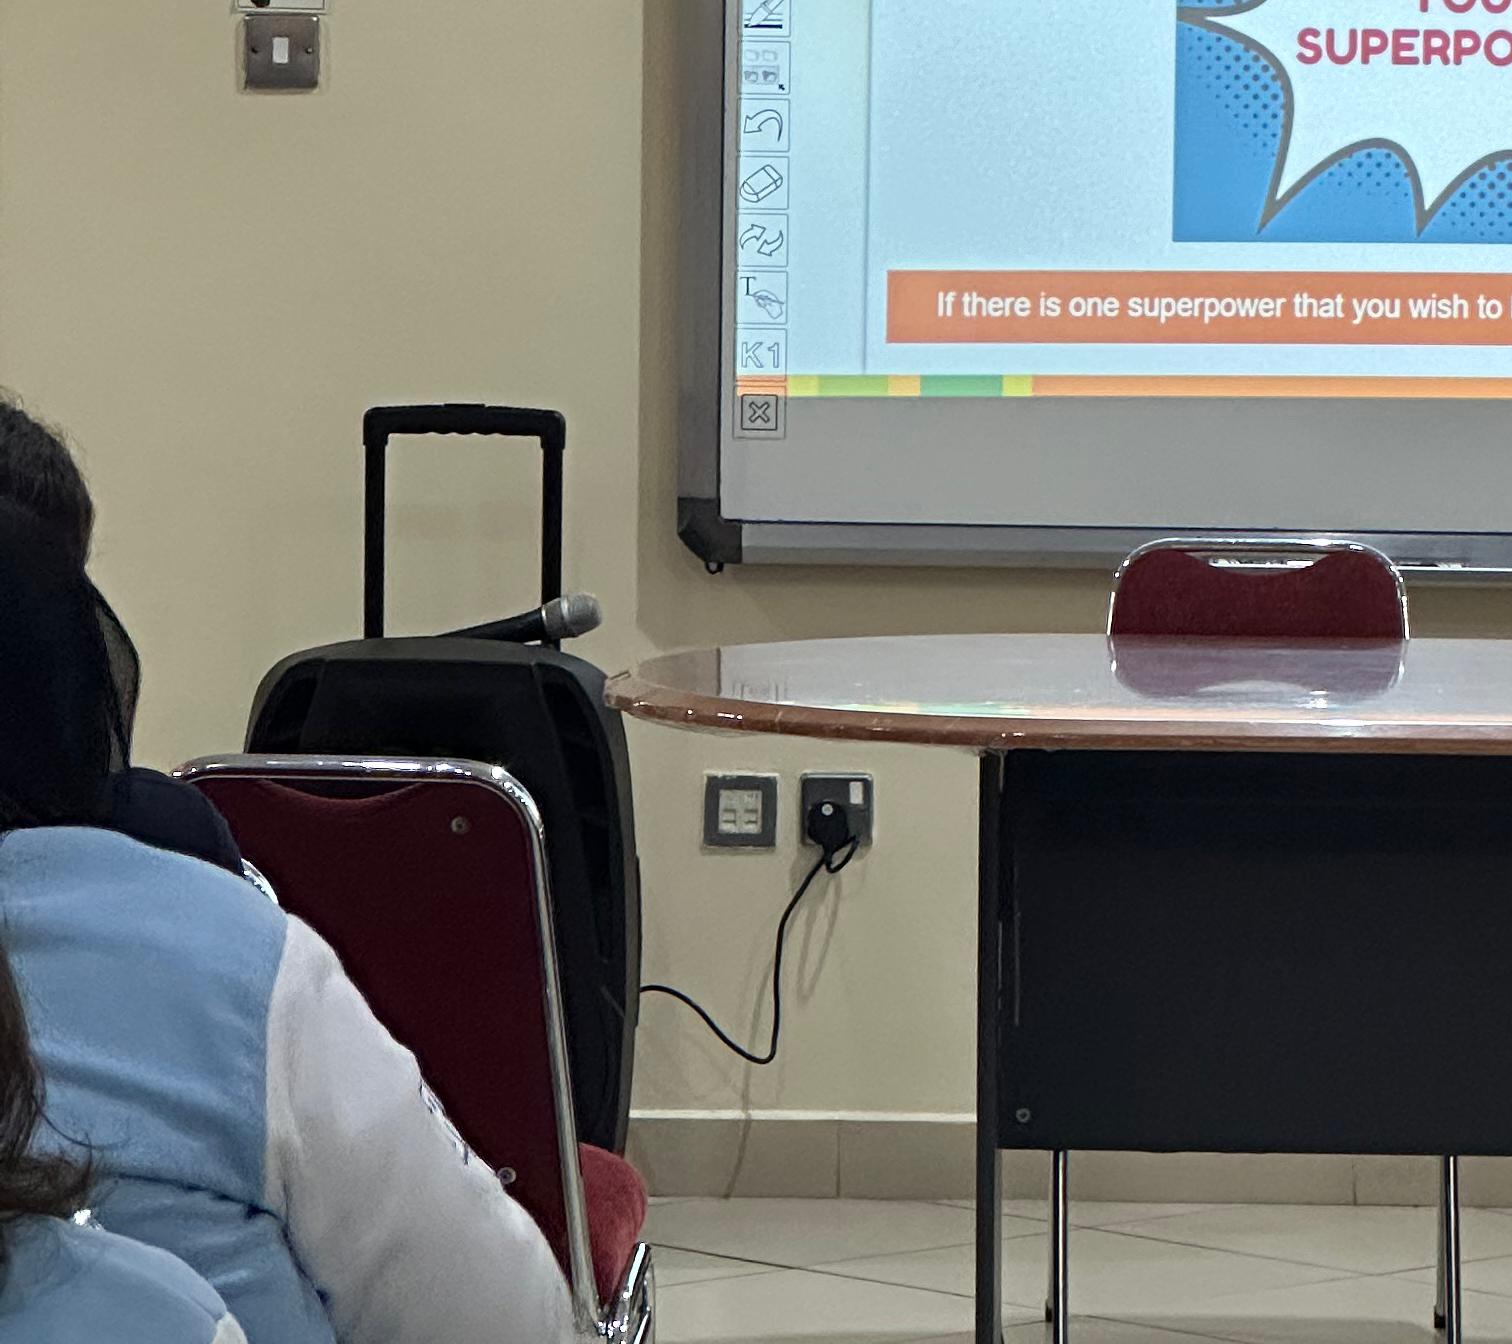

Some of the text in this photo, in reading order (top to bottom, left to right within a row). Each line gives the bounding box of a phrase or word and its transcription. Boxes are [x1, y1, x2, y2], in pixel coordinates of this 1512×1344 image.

[937, 291, 956, 317] If
[961, 291, 1031, 318] there
[1039, 292, 1062, 317] is
[1068, 297, 1120, 318] one
[1127, 297, 1287, 324] superpower
[1292, 292, 1345, 319] that
[1352, 297, 1401, 325] you
[1408, 293, 1469, 319] wish
[1477, 294, 1503, 320] to
[741, 341, 780, 369] K1
